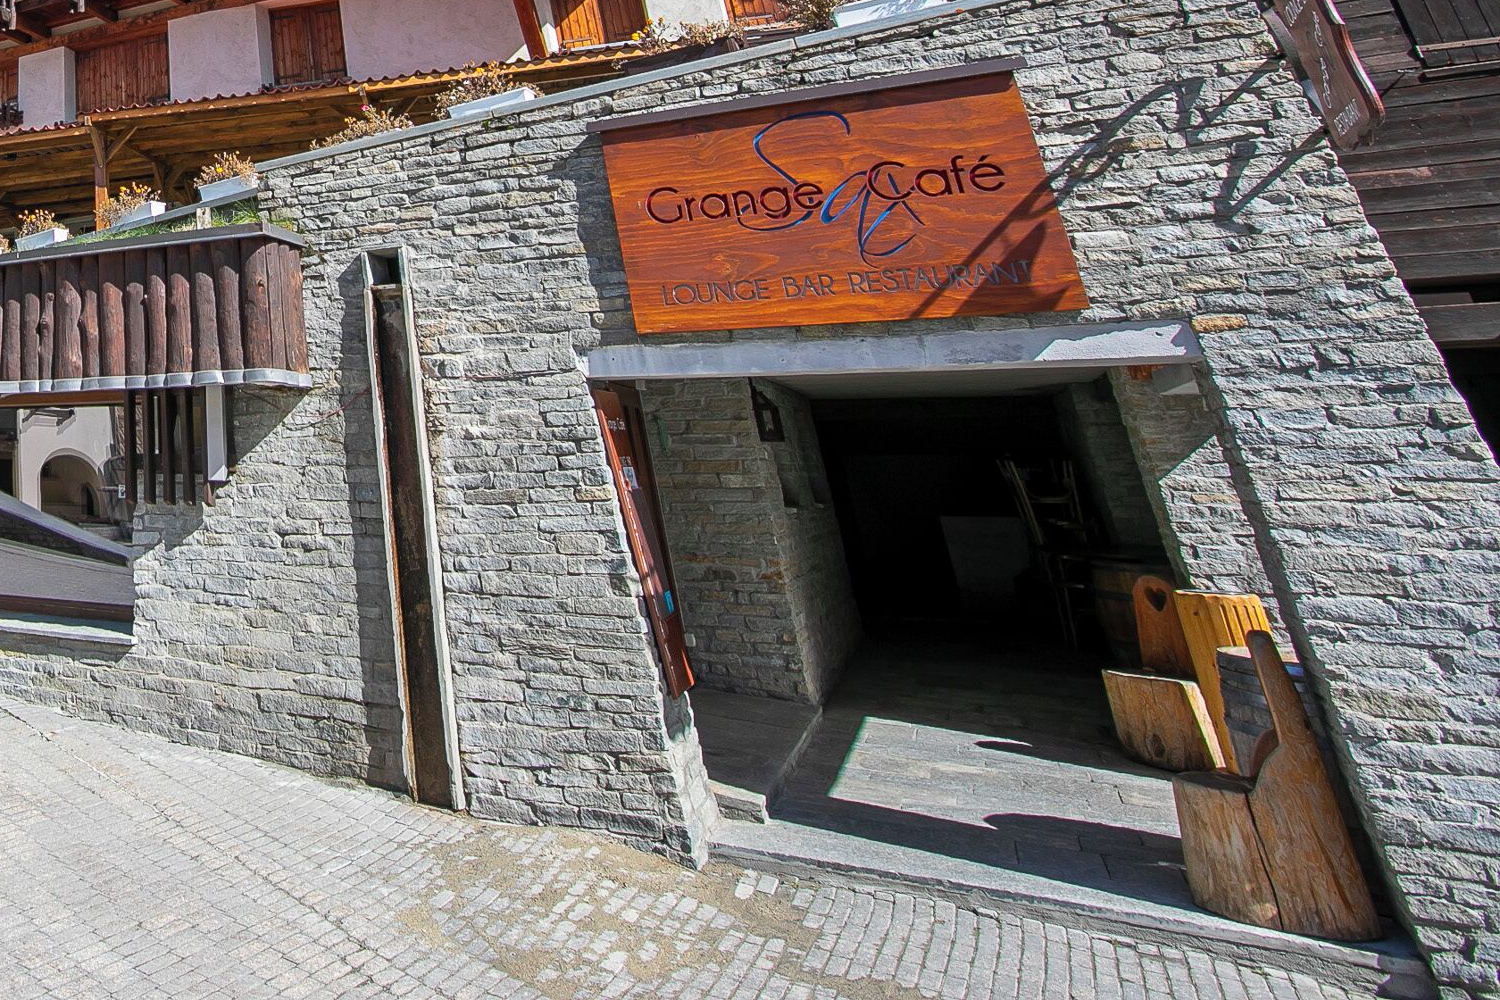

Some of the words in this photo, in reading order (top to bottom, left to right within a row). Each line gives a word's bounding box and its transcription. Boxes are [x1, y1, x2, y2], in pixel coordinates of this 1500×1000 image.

[644, 181, 825, 225] Grange
[866, 154, 1006, 203] Café
[661, 278, 771, 307] LOUNGE
[781, 271, 836, 299] BAR
[847, 260, 1033, 296] RESTAURANT
